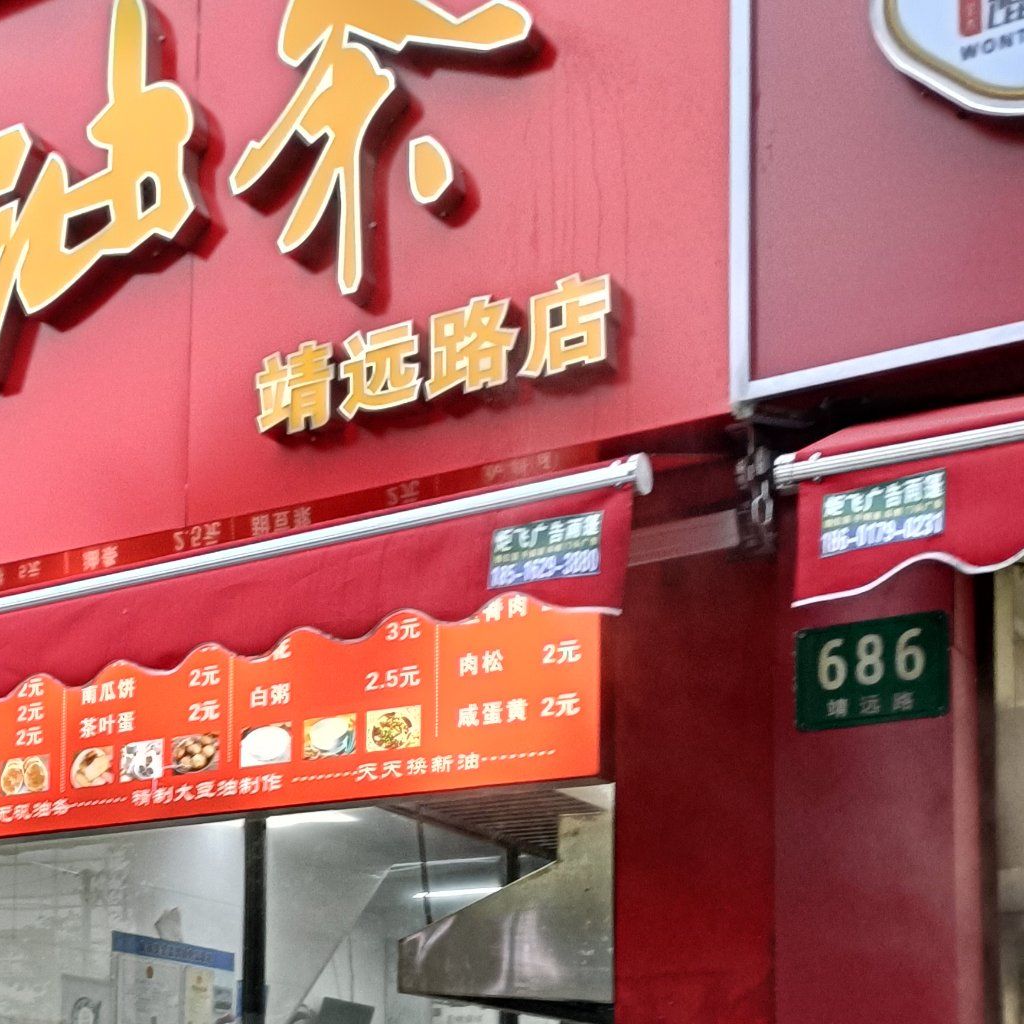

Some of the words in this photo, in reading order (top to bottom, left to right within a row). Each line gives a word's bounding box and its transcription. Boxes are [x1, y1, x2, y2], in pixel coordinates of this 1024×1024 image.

[255, 272, 613, 436] 靖远路店
[385, 618, 421, 642] 3元
[458, 649, 505, 677] 肉松
[542, 639, 582, 664] 2元
[818, 628, 926, 691] 686
[188, 665, 221, 688] 2元
[249, 682, 291, 708] 白粥
[364, 665, 421, 692] 2.5元
[17, 702, 45, 723] 2元
[79, 710, 136, 739] 茶叶蛋
[187, 700, 221, 722] 2元
[458, 699, 529, 728] 咸蛋黄
[541, 693, 581, 718] 2元
[15, 726, 45, 747] 2元
[355, 752, 481, 783] 天天换新油
